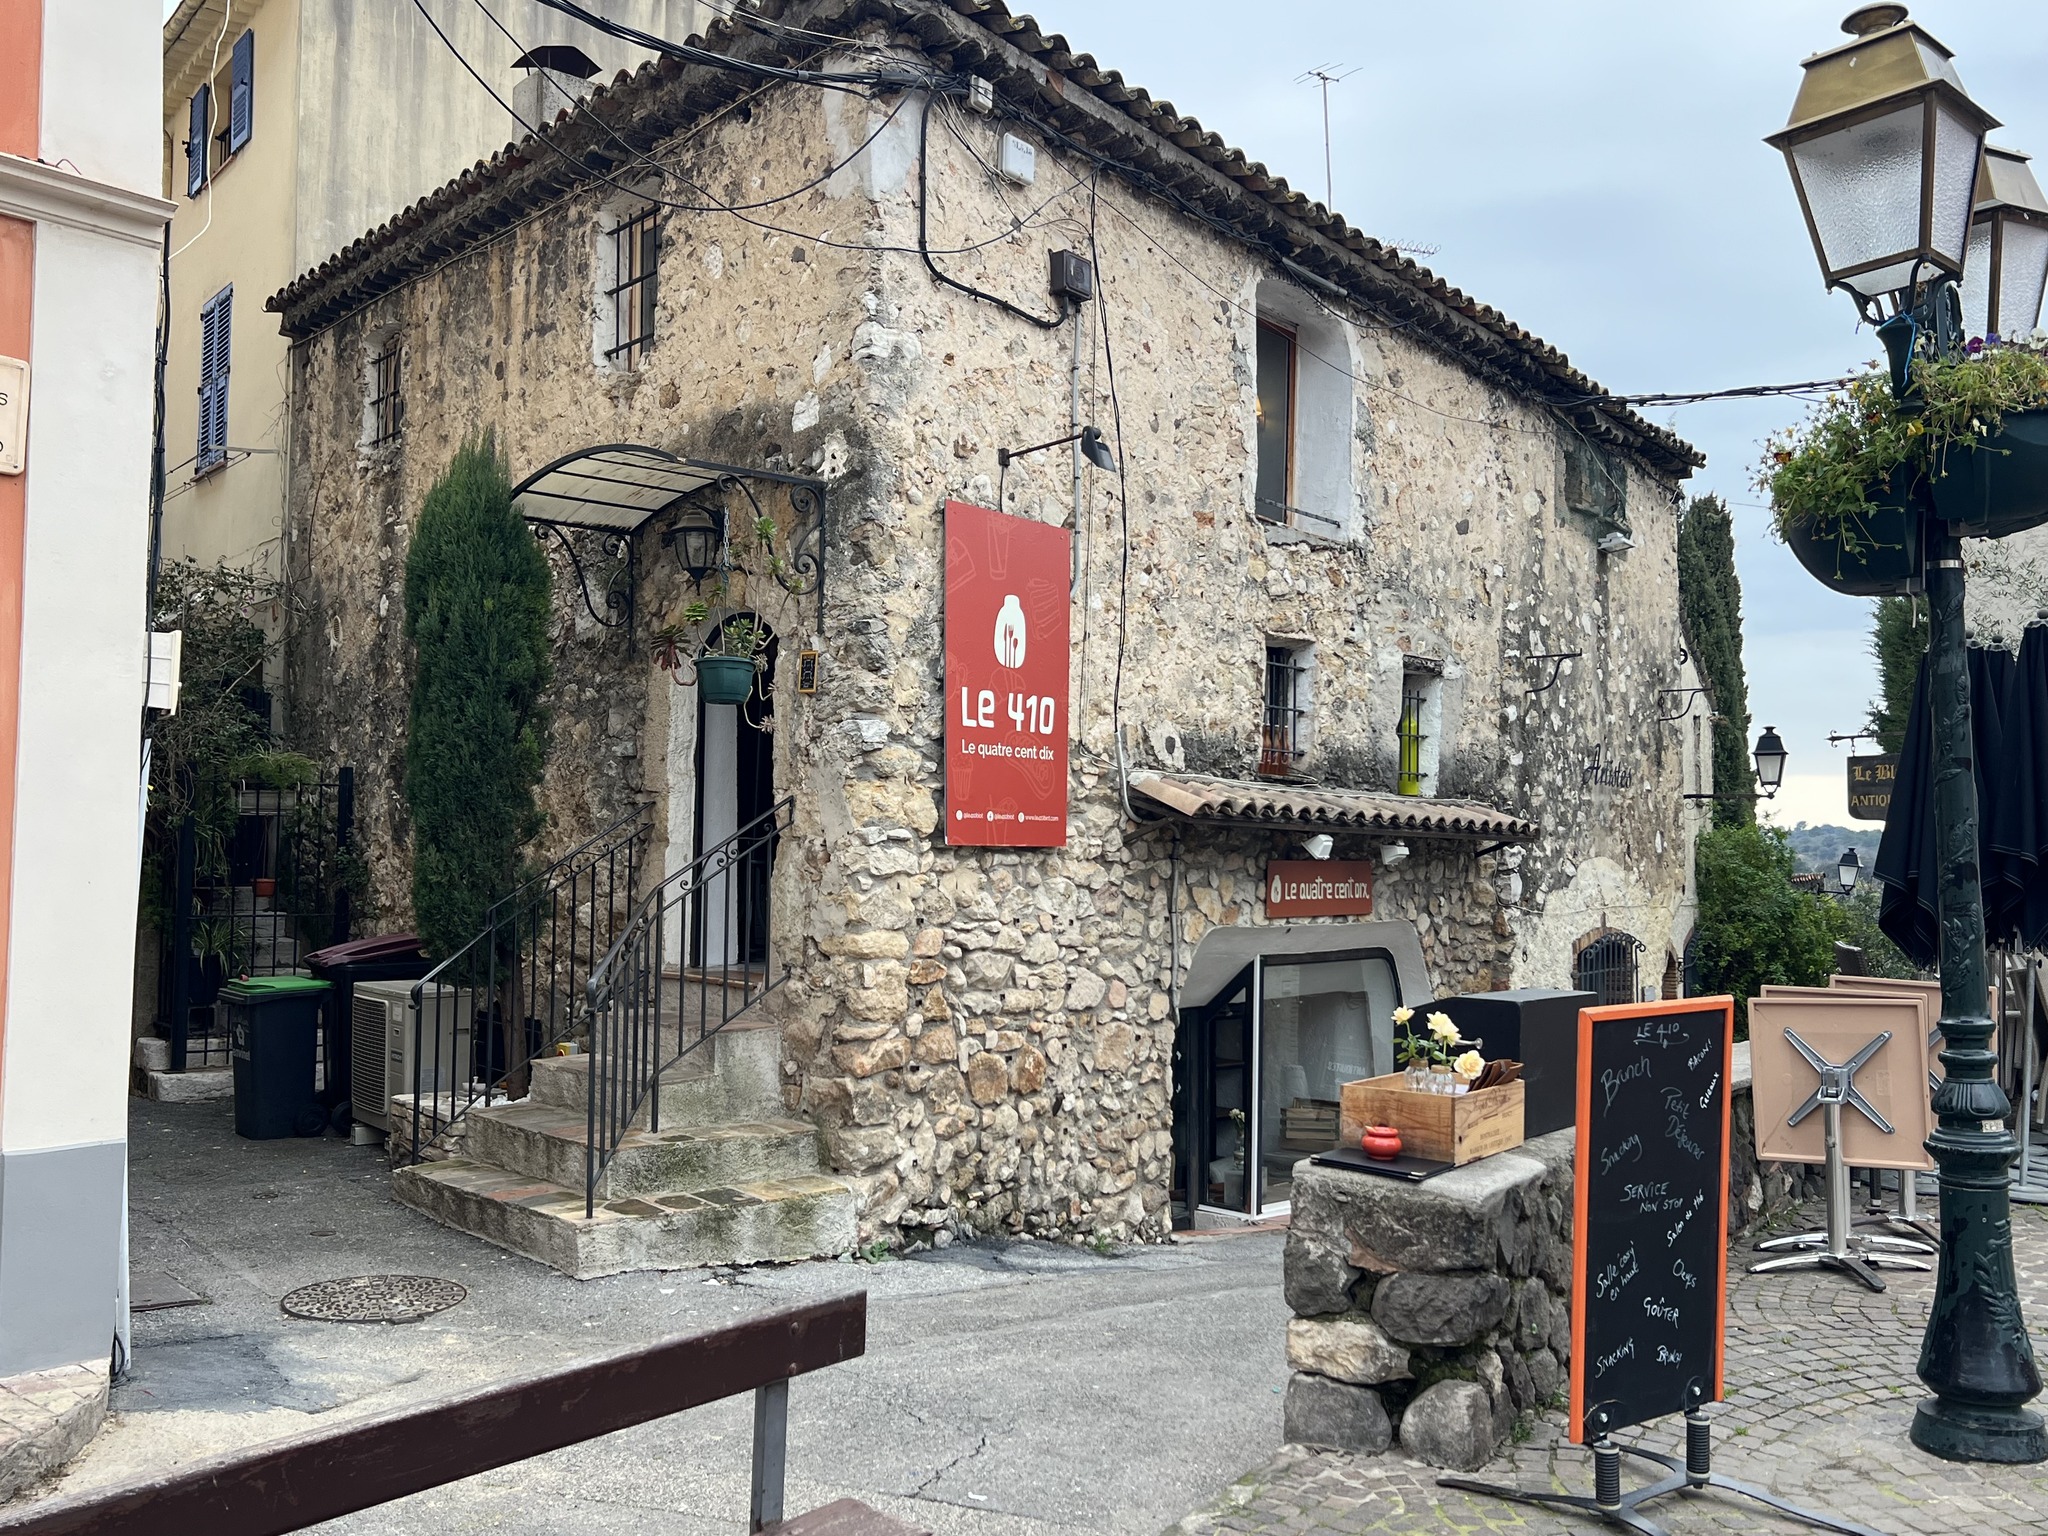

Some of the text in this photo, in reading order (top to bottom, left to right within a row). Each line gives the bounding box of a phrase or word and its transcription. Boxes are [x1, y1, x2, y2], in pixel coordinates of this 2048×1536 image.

[962, 686, 1055, 735] Le 410
[961, 739, 1054, 760] Le quatre cent dix
[1852, 766, 1872, 781] Le
[1637, 1022, 1680, 1044] LE 410
[1600, 1055, 1652, 1118] Brunch
[1660, 1086, 1690, 1119] Petit
[1601, 1134, 1643, 1176] Snacking
[1662, 1198, 1683, 1210] STOP
[1666, 1221, 1684, 1248] Salon
[1596, 1264, 1619, 1298] Salle
[1610, 1260, 1640, 1301] en haut
